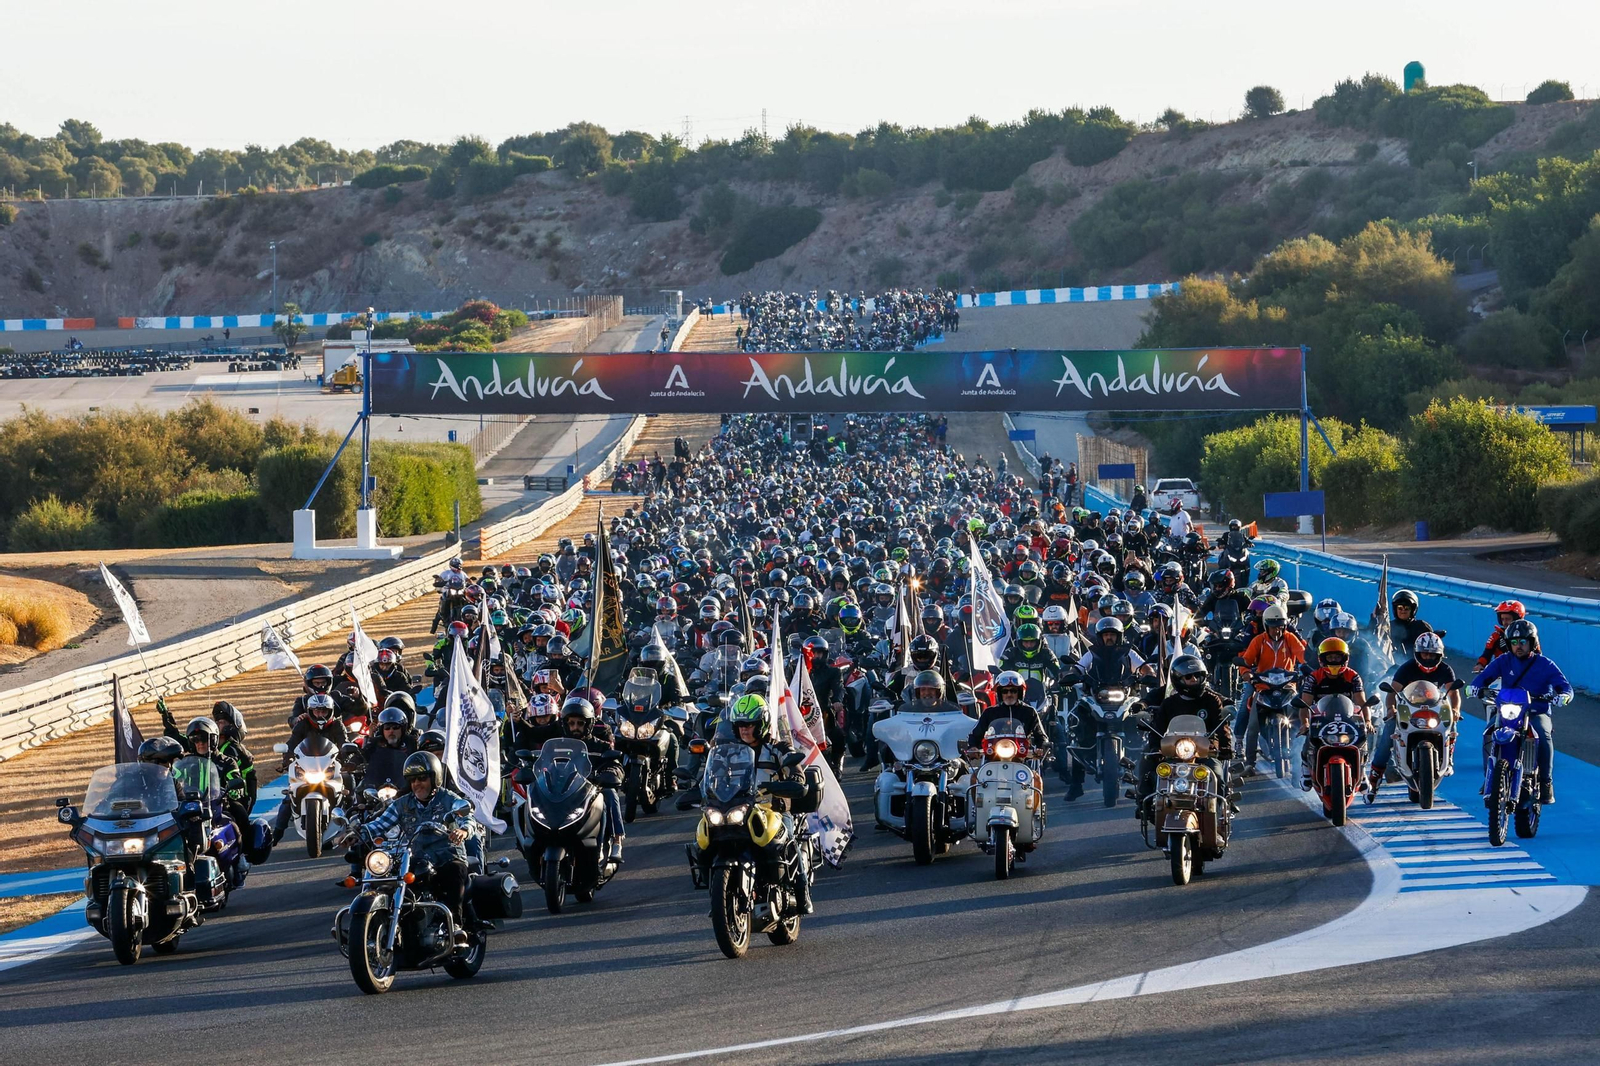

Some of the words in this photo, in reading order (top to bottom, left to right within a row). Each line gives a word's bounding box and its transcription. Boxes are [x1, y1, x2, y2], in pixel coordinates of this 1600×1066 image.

[429, 357, 614, 402] Andalucía
[740, 356, 925, 400] Andalucía
[1053, 354, 1240, 399] Andalucía
[1326, 723, 1348, 735] 31
